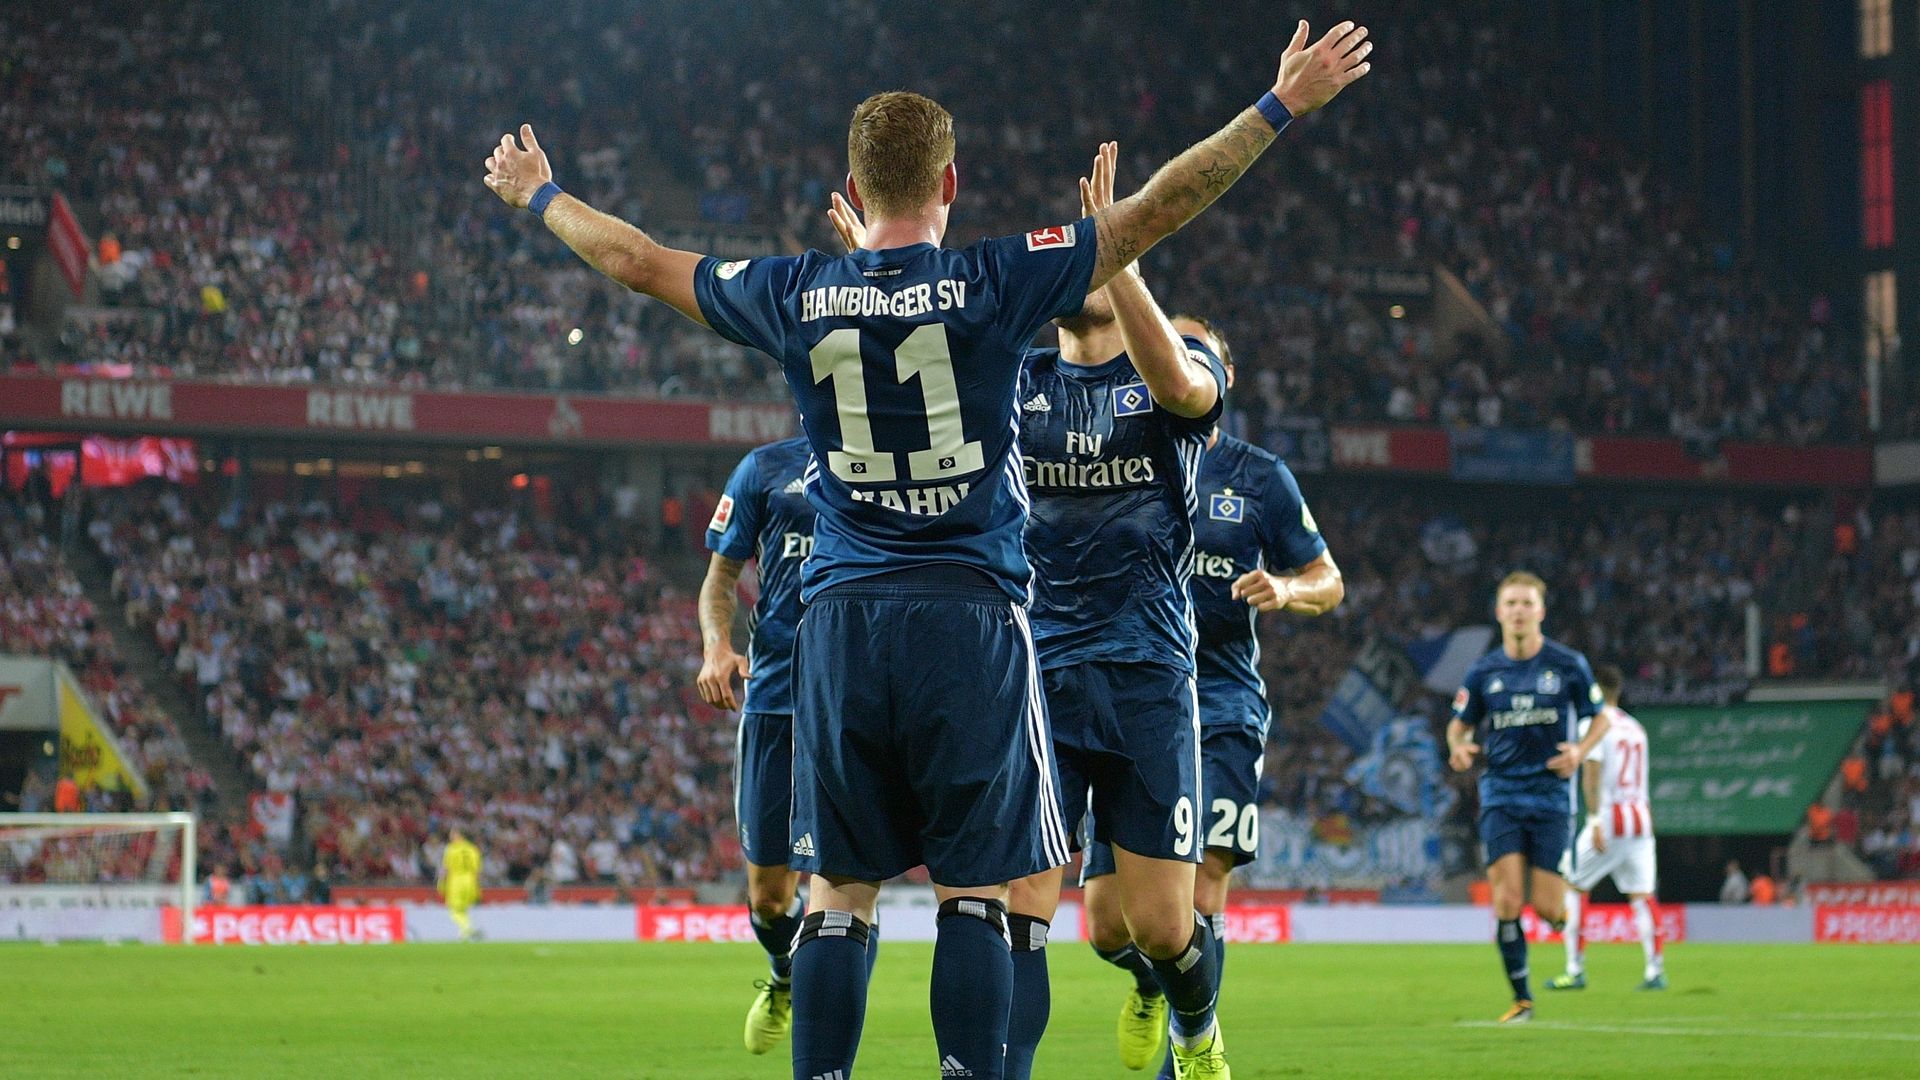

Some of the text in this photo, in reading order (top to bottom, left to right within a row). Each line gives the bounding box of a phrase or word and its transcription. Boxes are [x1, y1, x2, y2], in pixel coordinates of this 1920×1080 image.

[801, 279, 966, 322] HAMBURGER SV
[61, 379, 174, 420] REWE
[307, 391, 415, 430] REWE
[808, 322, 986, 482] 11
[1066, 431, 1103, 457] Fly
[1022, 455, 1155, 487] Emirates
[1617, 738, 1642, 787] 21
[1174, 796, 1193, 856] 9
[1206, 797, 1259, 852] 20
[213, 912, 391, 944] PEGASUS
